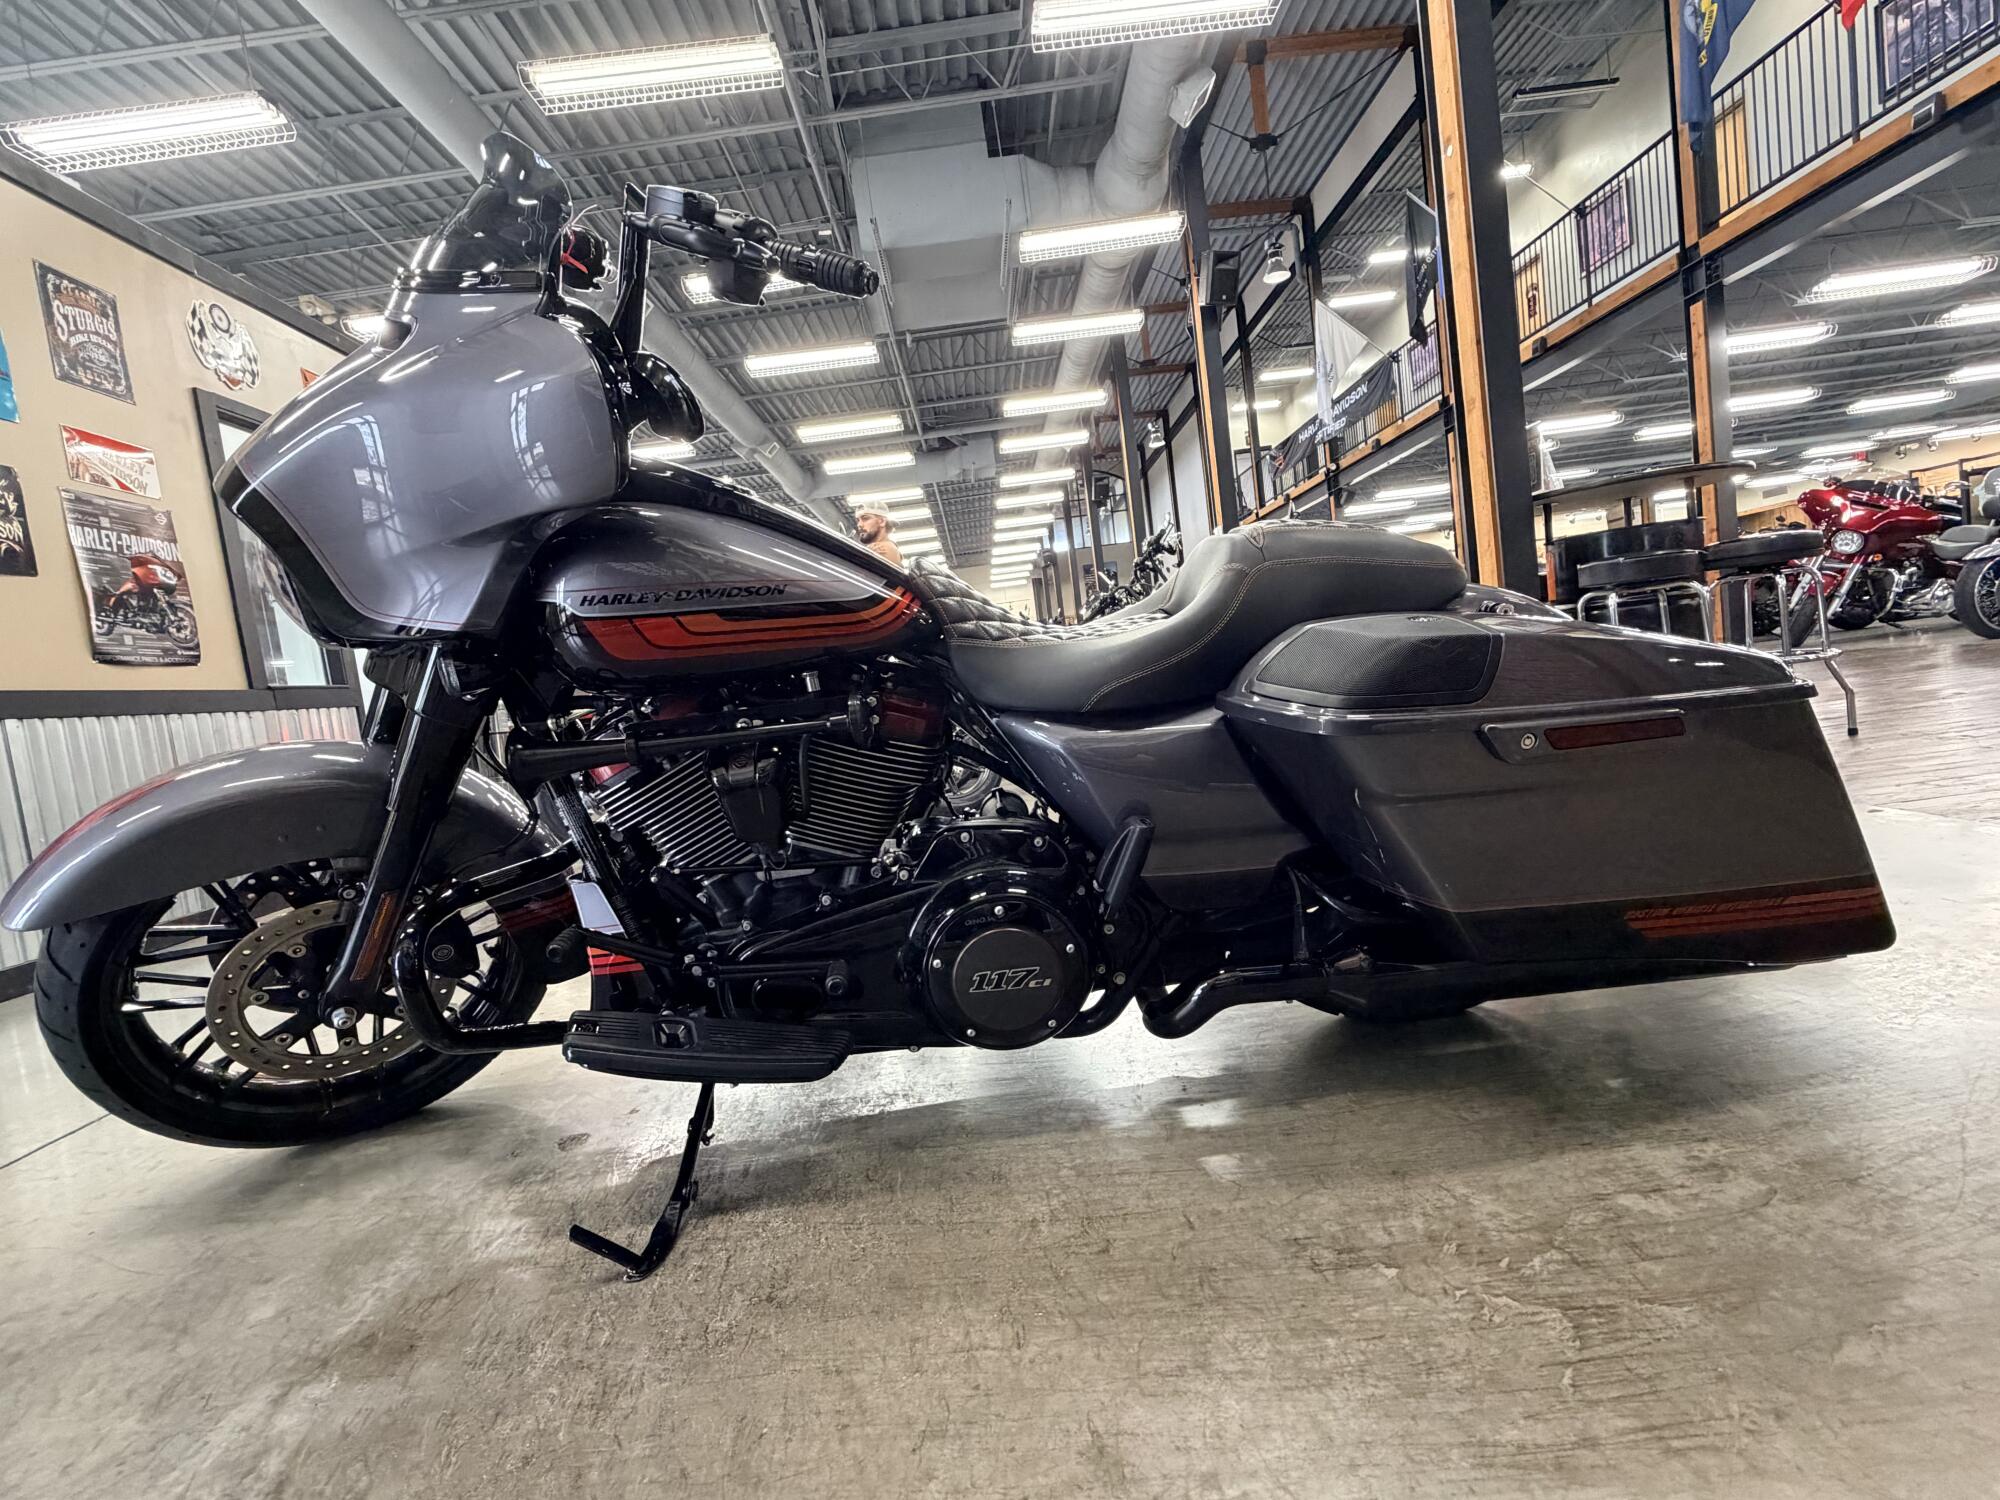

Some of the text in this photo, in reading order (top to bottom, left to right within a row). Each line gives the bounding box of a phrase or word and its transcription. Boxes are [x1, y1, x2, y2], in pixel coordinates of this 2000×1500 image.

[53, 300, 117, 342] STURGIS
[67, 523, 181, 562] HARLEY-DAVIDSON
[579, 584, 788, 607] HARLEY-DAVIDSON
